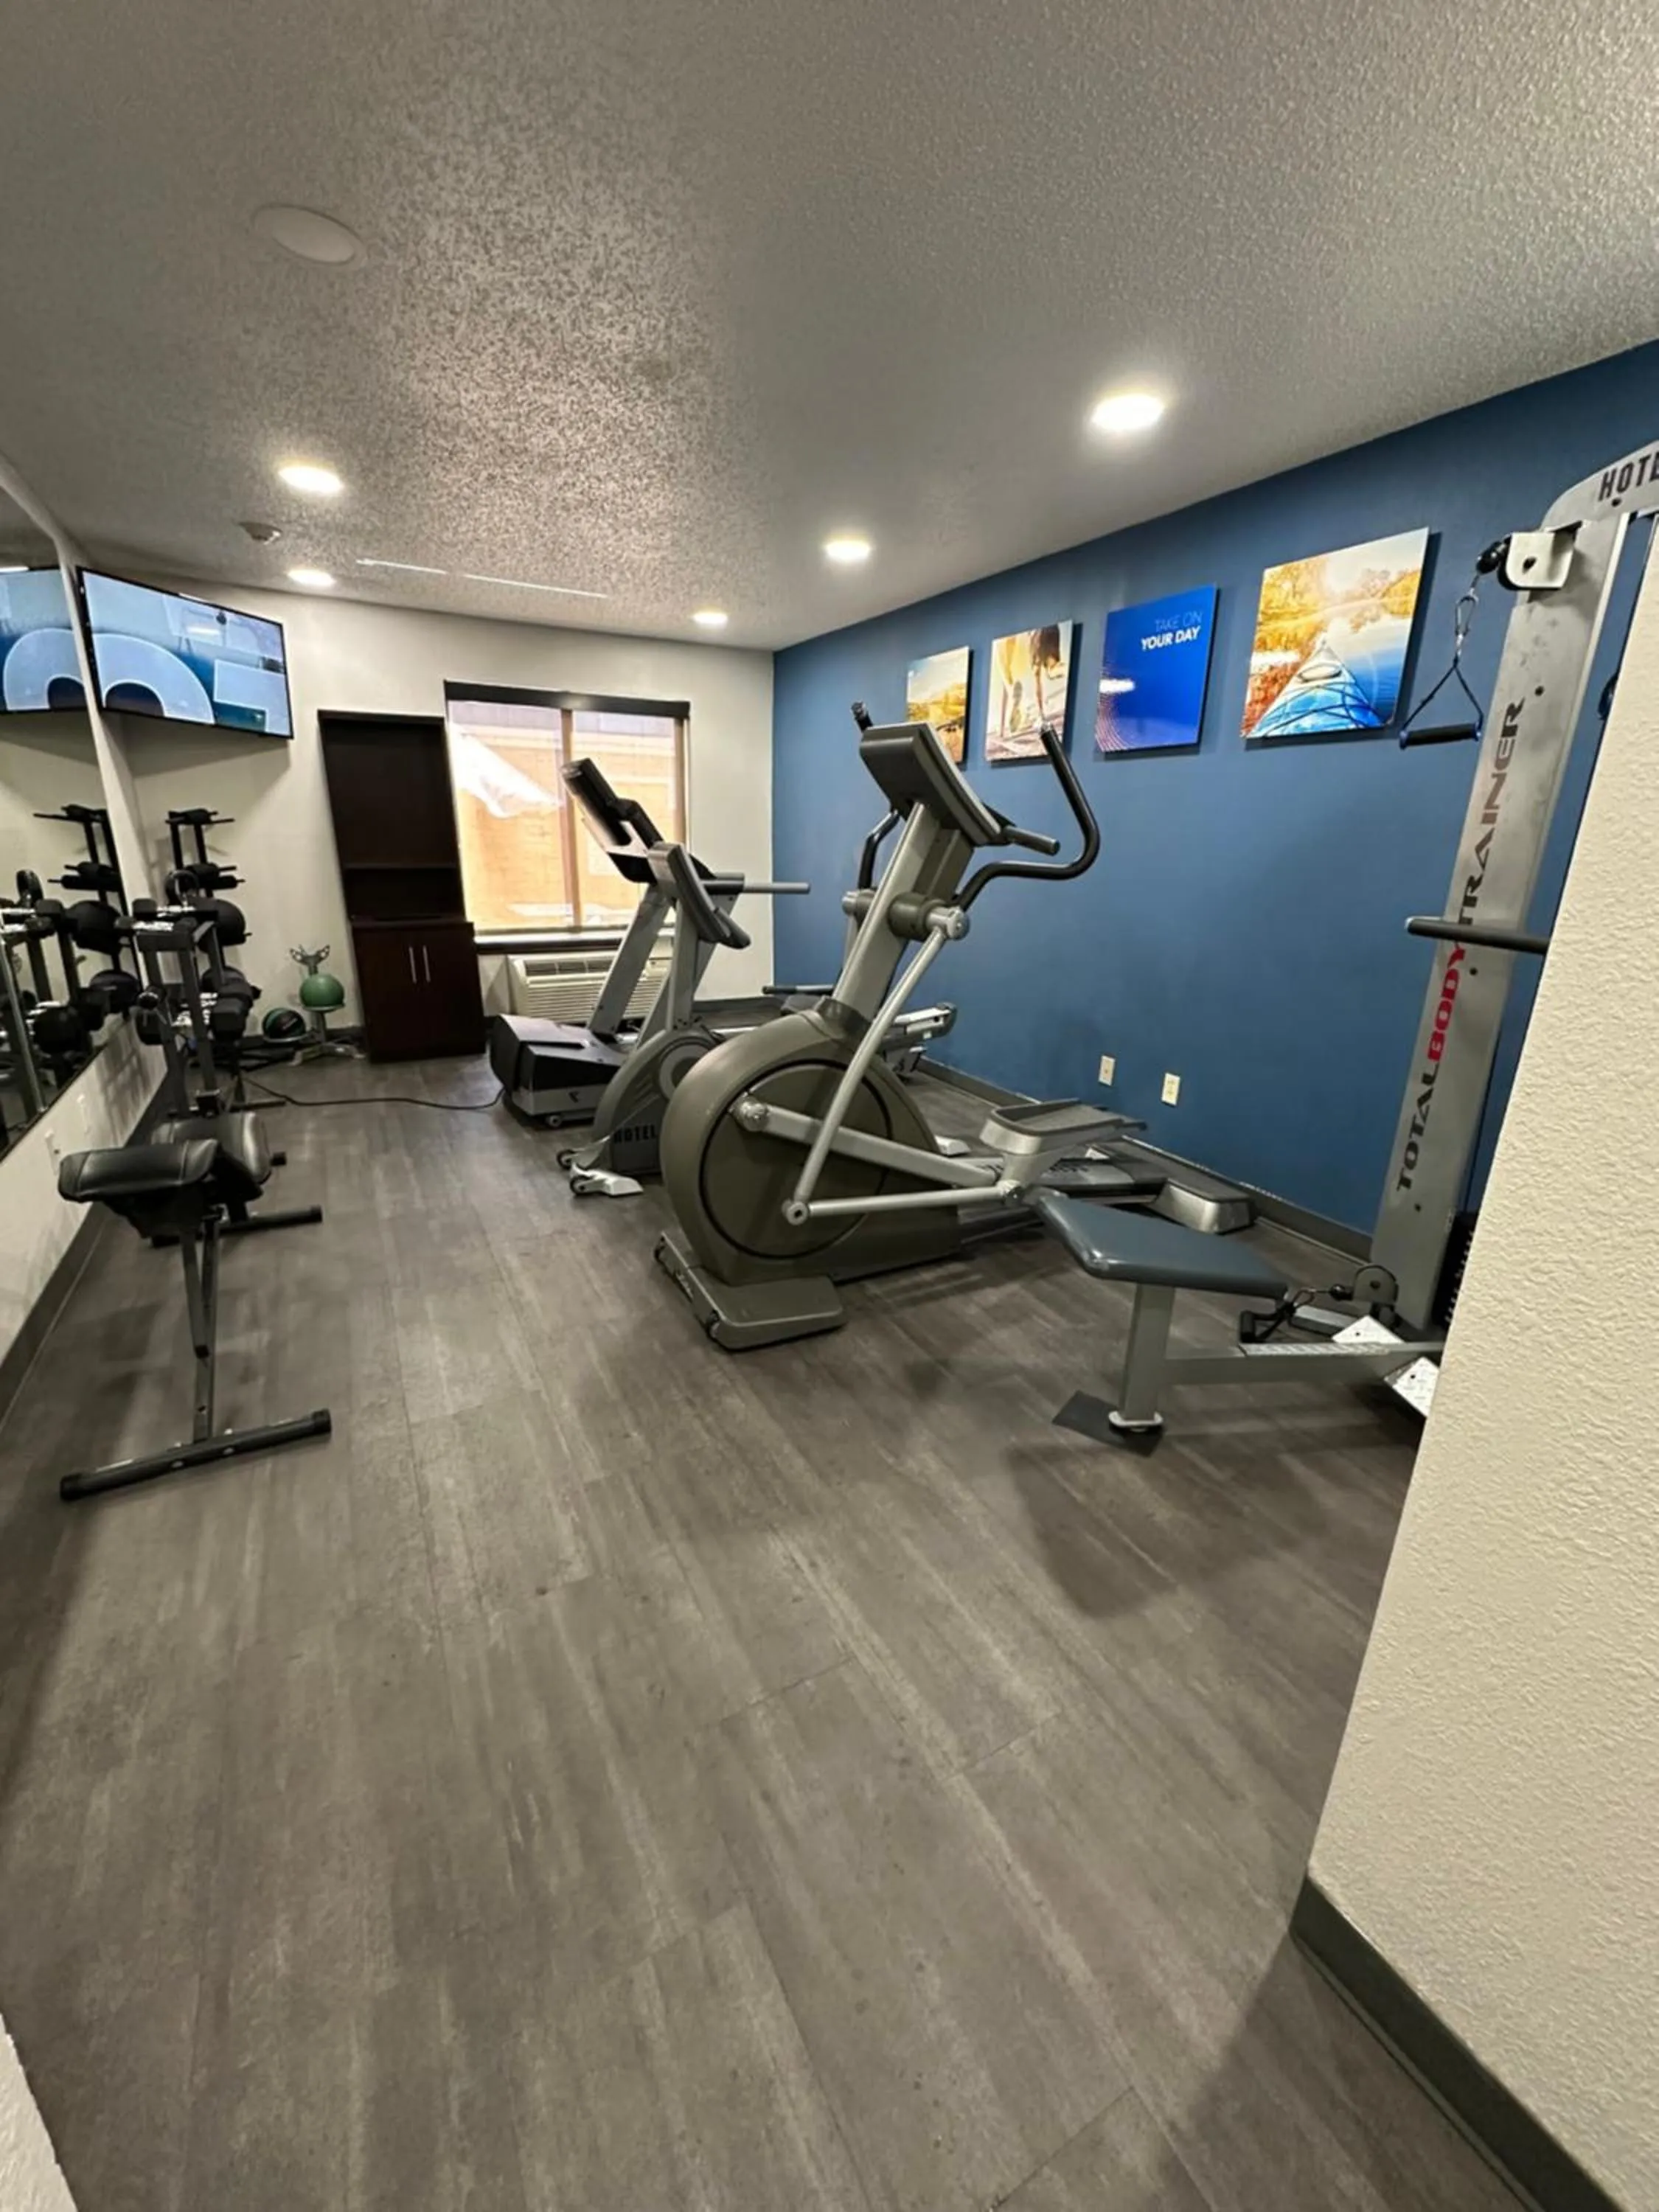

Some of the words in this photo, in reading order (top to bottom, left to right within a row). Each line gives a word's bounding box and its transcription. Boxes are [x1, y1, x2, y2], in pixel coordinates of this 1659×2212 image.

[1154, 614, 1180, 633] TAKE
[1183, 611, 1203, 627] ON
[1141, 632, 1174, 652] YOUR
[1175, 625, 1201, 644] DAY
[613, 1124, 656, 1144] HOTEL
